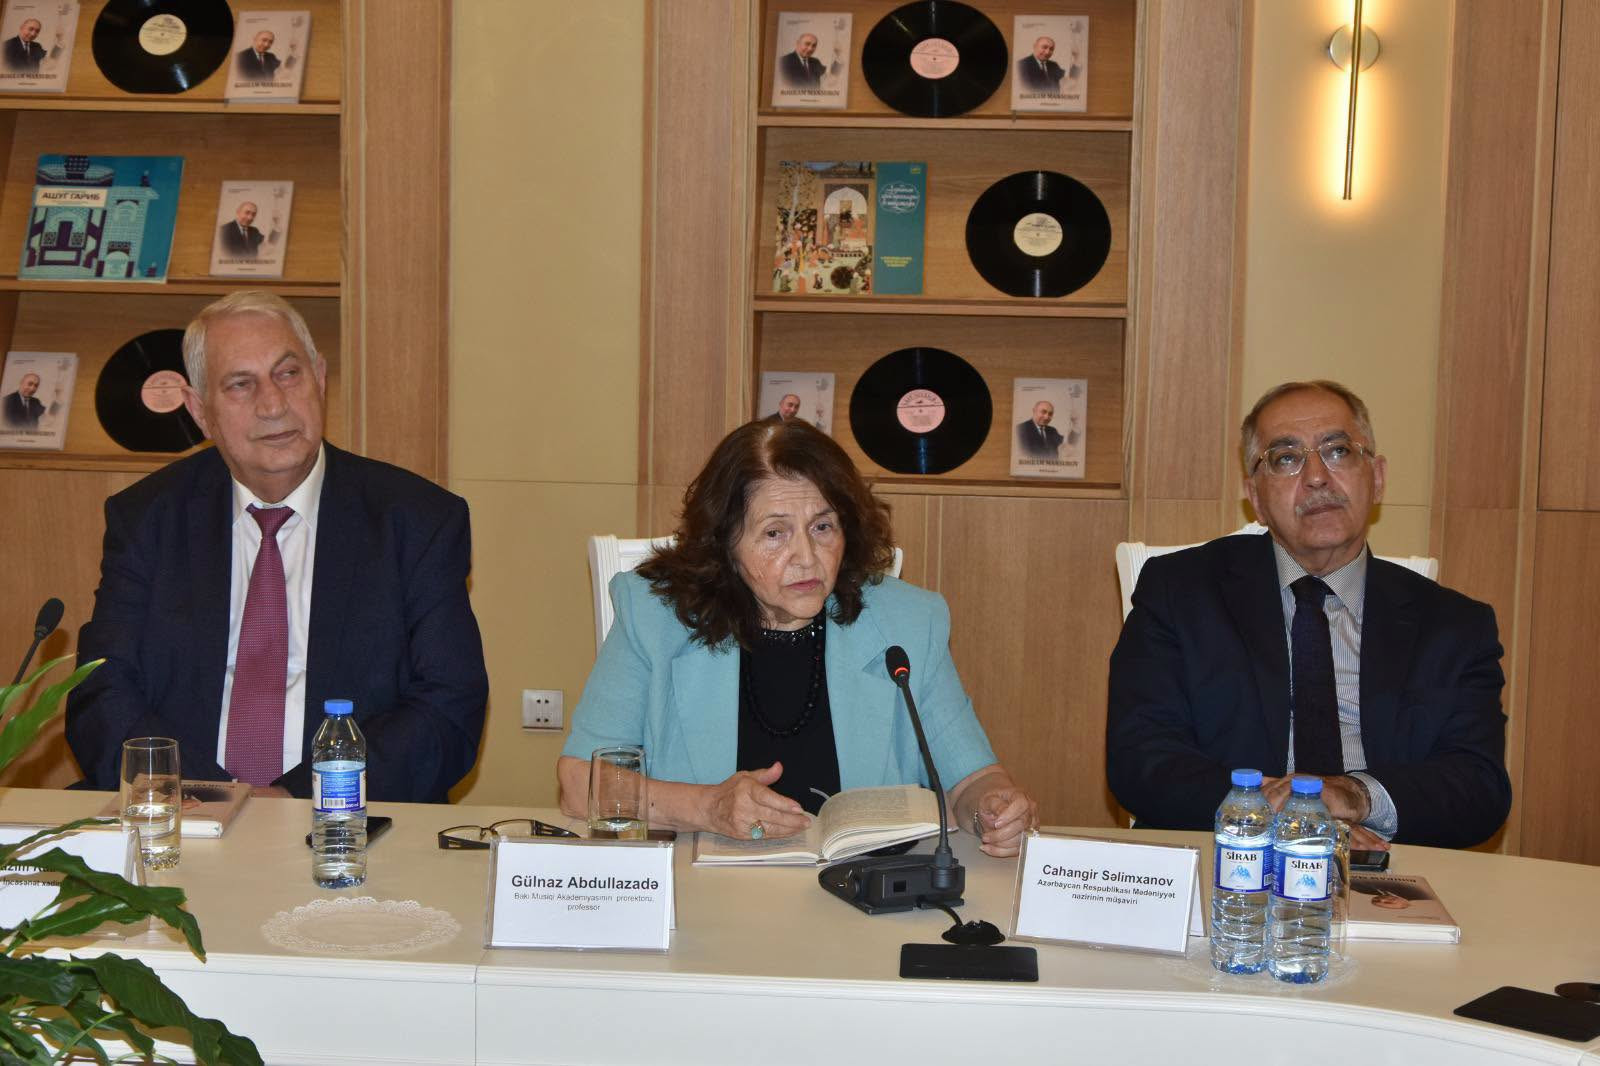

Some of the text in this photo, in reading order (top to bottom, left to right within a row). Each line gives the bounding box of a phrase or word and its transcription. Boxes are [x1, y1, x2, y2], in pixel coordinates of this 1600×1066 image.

[511, 875, 659, 890] Gülnaz Abdullazadə
[1042, 864, 1174, 887] Cahangir Səlimxanov
[1037, 879, 1176, 899] Azərbaycan Respublikası Mədəniyyət
[531, 893, 555, 901] Musiqi
[1071, 893, 1138, 905] nazirinin müşaviri
